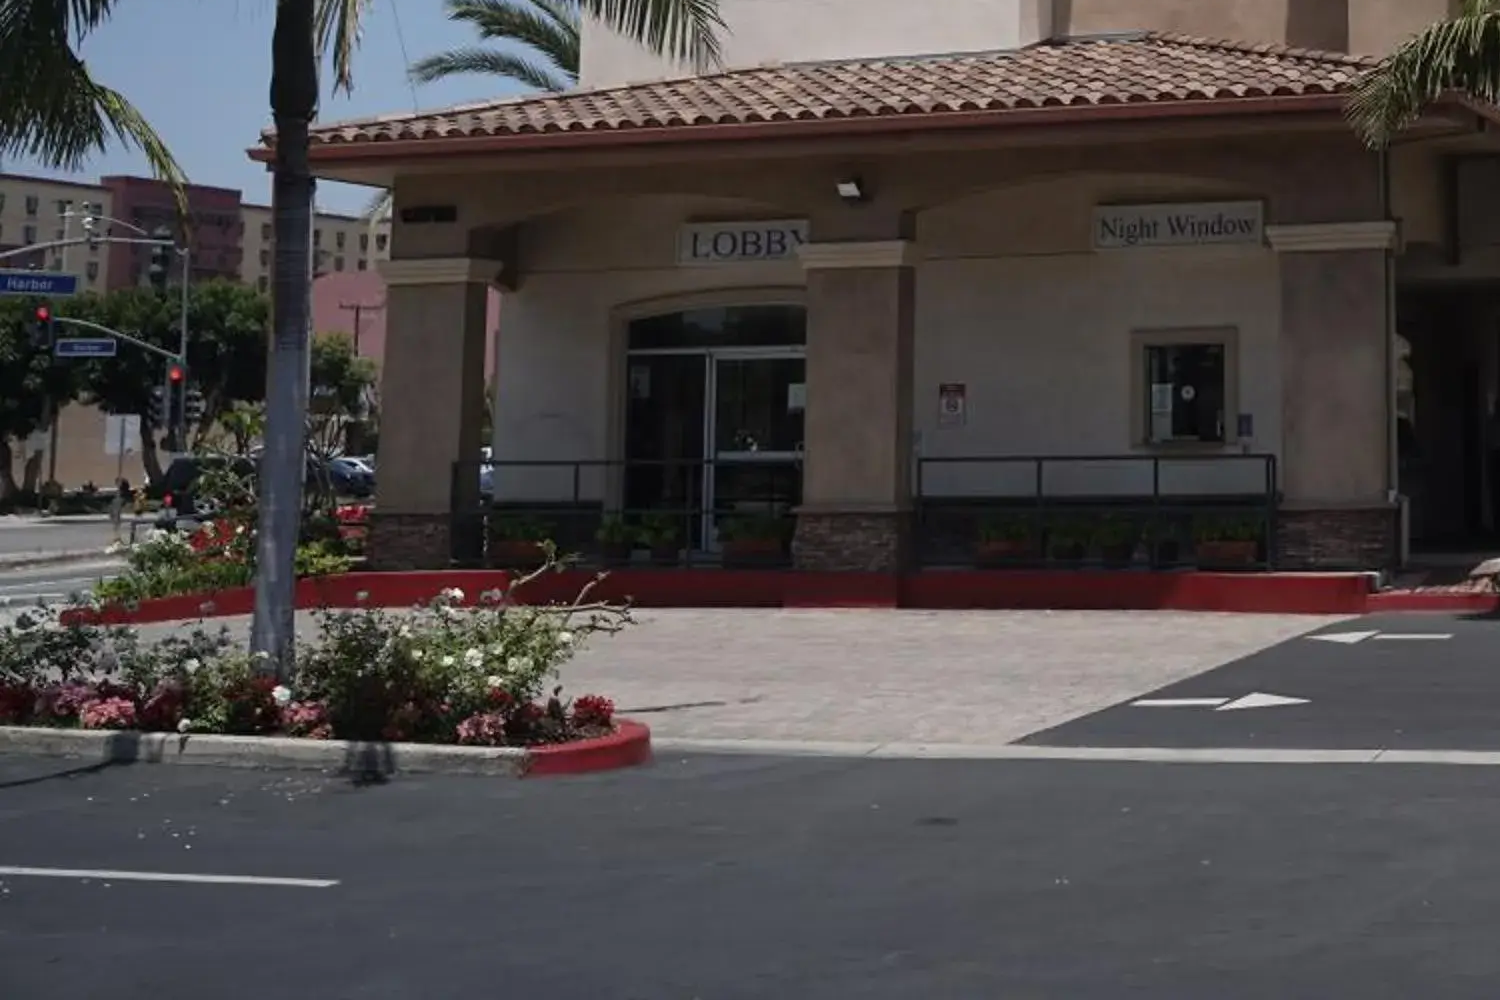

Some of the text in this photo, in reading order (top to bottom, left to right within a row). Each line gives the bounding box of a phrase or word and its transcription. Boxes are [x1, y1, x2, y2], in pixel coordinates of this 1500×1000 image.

[1100, 212, 1255, 245] Night Window
[7, 277, 53, 290] Harbor
